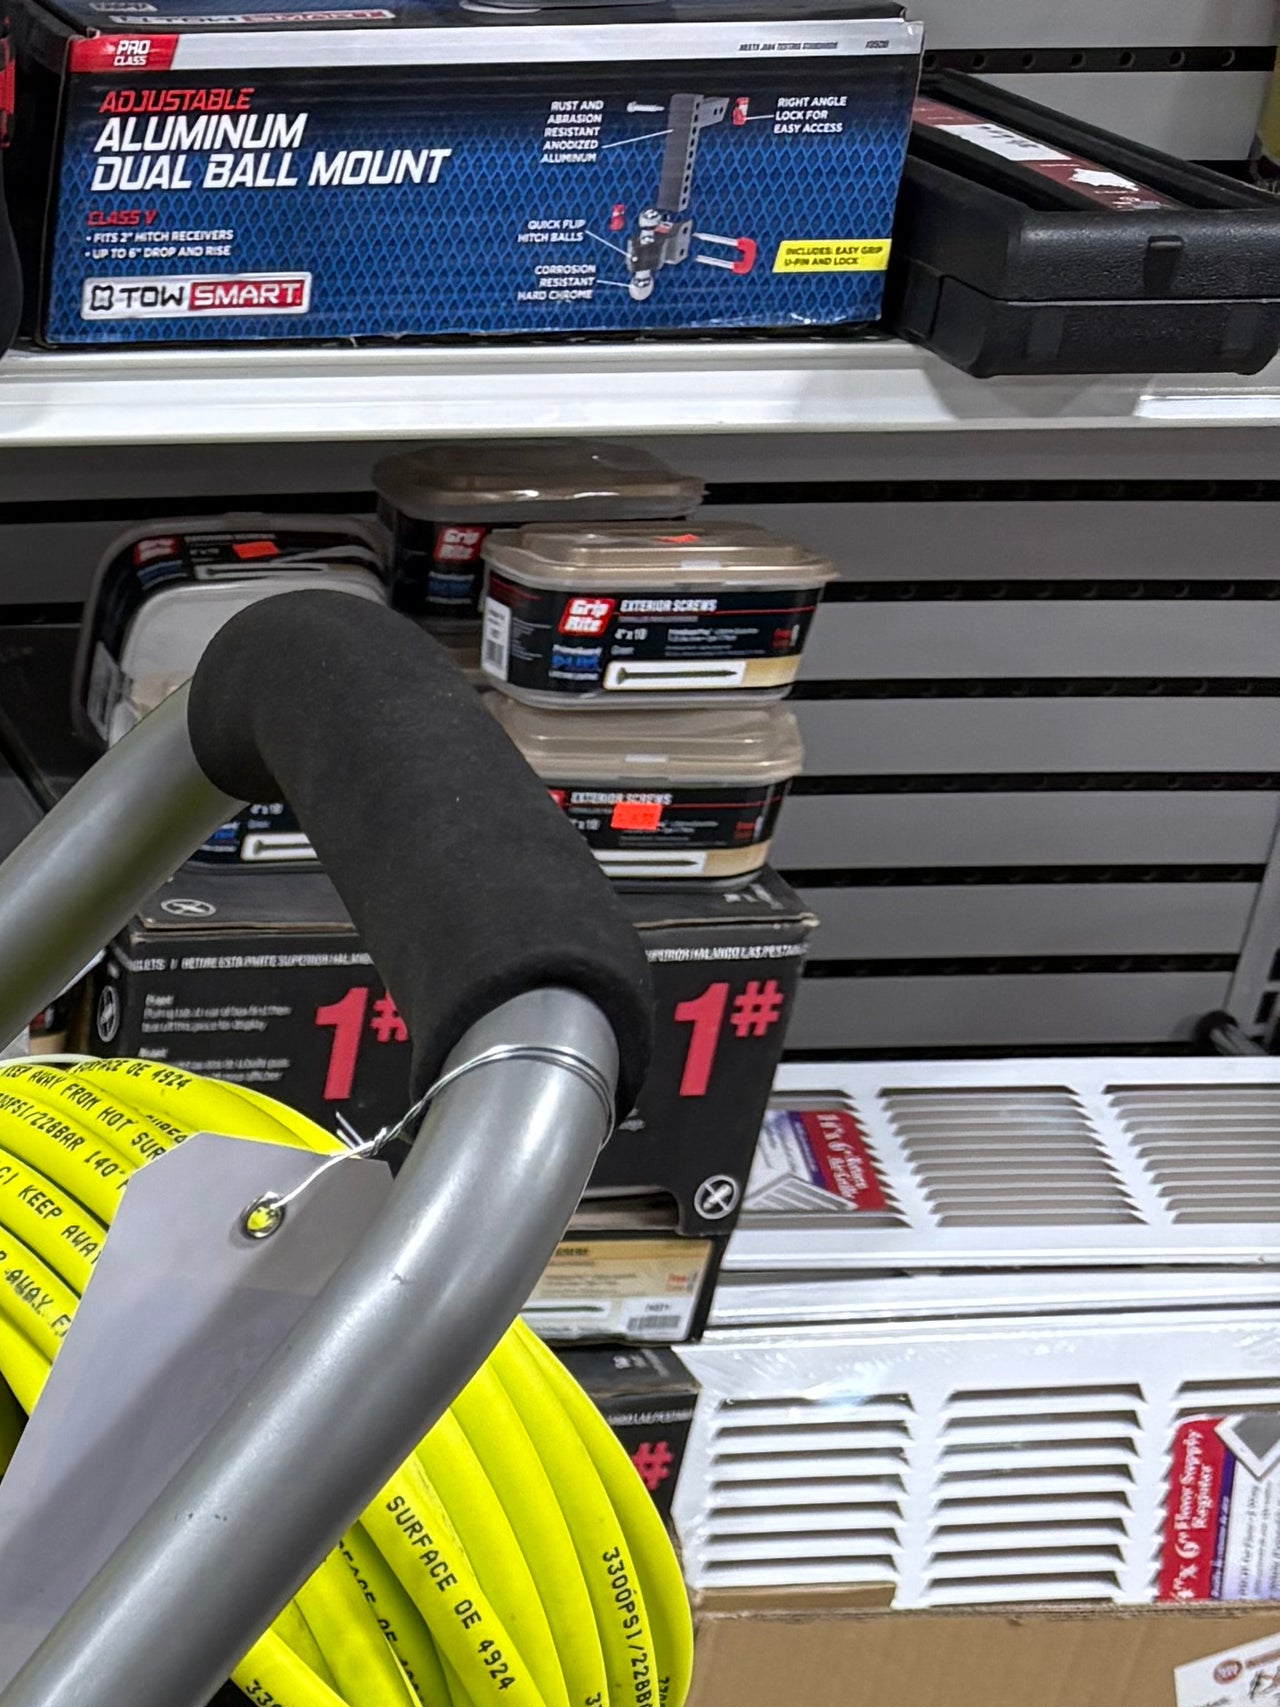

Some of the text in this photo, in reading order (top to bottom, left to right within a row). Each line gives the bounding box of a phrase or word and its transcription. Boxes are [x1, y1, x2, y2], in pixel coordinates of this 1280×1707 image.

[116, 39, 151, 56] PRO
[113, 56, 148, 67] CLASS
[98, 88, 255, 114] ADJUSTABLE
[551, 100, 604, 112] RUST AND
[777, 96, 847, 108] RIGHT ANGLE
[547, 113, 602, 124] ABRASION
[775, 109, 828, 121] LOCK FOR
[93, 113, 308, 153] ALUMINUM
[545, 126, 600, 137] RESISTANT
[774, 123, 843, 134] EASY ACCESS
[543, 139, 598, 150] ANODIZED
[541, 152, 597, 164] ALUMINUM
[90, 148, 452, 192] DUAL BALL MOUNT
[86, 210, 140, 226] CLASS
[527, 219, 586, 231] QUICK FLIP
[93, 229, 234, 243] FITS HITCH RECEIVERS
[518, 231, 584, 243] HITCH BALLS
[92, 245, 231, 259] UP TO DROP AND RISE
[534, 264, 596, 276] CORROSION
[539, 276, 595, 288] RESISTANT
[119, 282, 302, 309] TOW SMART
[517, 290, 593, 302] HARD CHROME
[620, 599, 718, 613] EXTERIOR SCREWS
[673, 979, 784, 1097] 1#
[151, 1068, 194, 1092] 4924
[28, 1070, 131, 1131] AWAY FROM HOT
[17, 1184, 64, 1221] KEEP
[386, 1494, 517, 1692] SURFACE OE 4924
